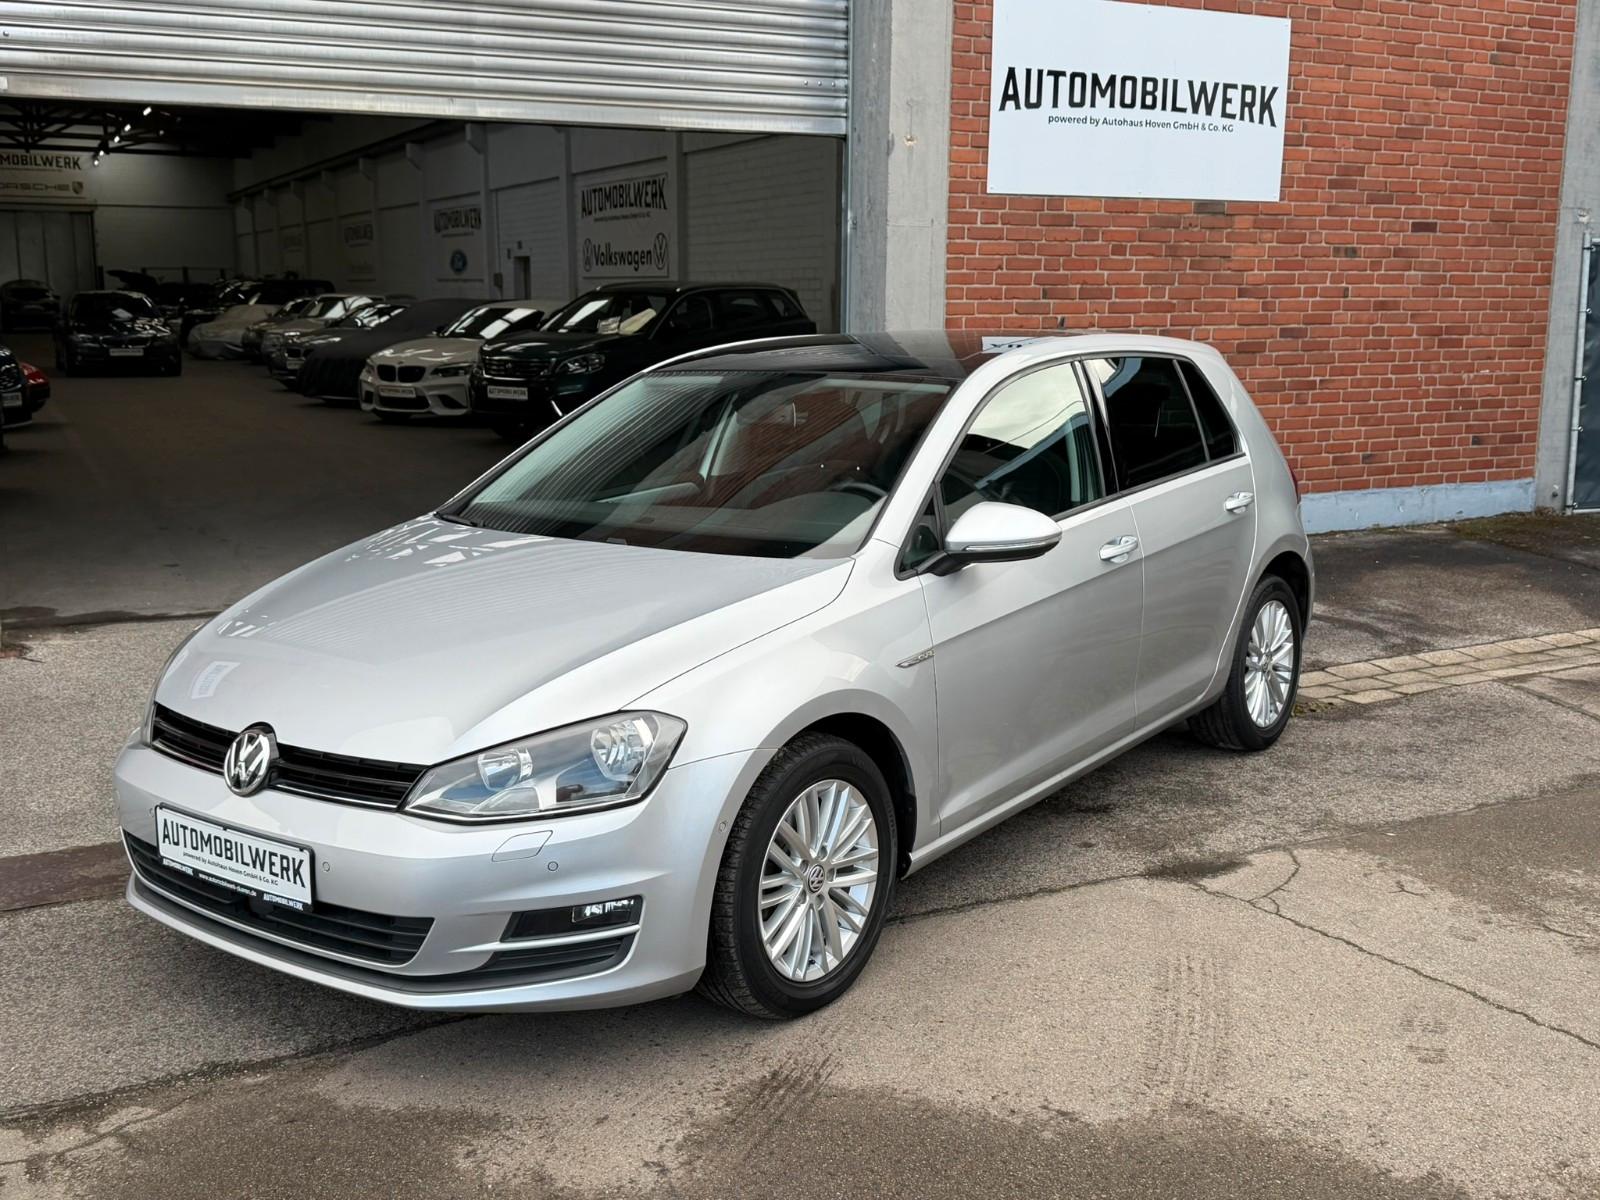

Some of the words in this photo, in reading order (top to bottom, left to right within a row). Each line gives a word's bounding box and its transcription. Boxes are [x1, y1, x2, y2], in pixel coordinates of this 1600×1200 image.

[998, 66, 1280, 128] AUTOMOBILWERK
[1048, 115, 1088, 125] powered
[1089, 116, 1101, 127] by
[1102, 117, 1143, 128] Autohaus
[1145, 119, 1171, 129] Hoven
[1173, 121, 1199, 131] GmbH
[1201, 123, 1206, 131] &
[1208, 124, 1221, 132] Co.
[1222, 124, 1234, 133] KG
[581, 178, 668, 219] AUTOMOBILWERK
[593, 241, 653, 272] Volkswagen
[162, 818, 306, 888] AUTOMOBILWERK
